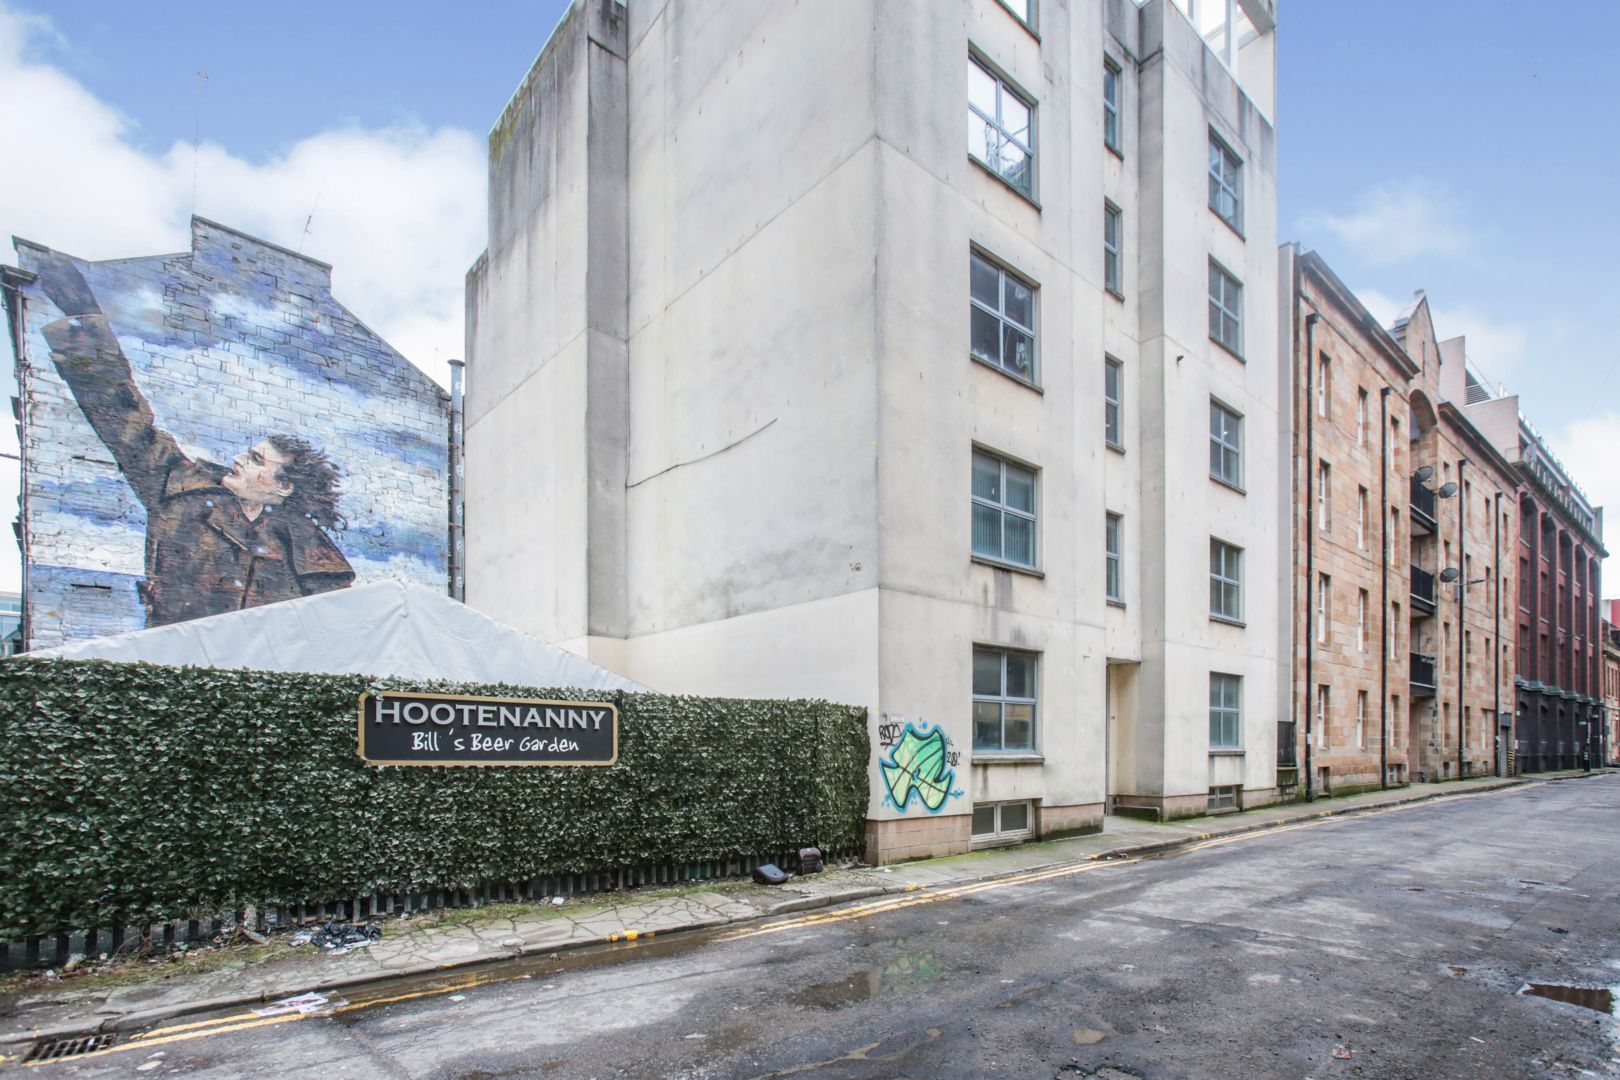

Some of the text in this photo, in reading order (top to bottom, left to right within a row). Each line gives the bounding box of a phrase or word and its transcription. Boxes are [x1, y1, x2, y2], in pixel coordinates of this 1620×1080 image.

[374, 700, 607, 729] HOOTENANNY
[470, 733, 514, 751] Beer
[519, 736, 580, 752] Garden
